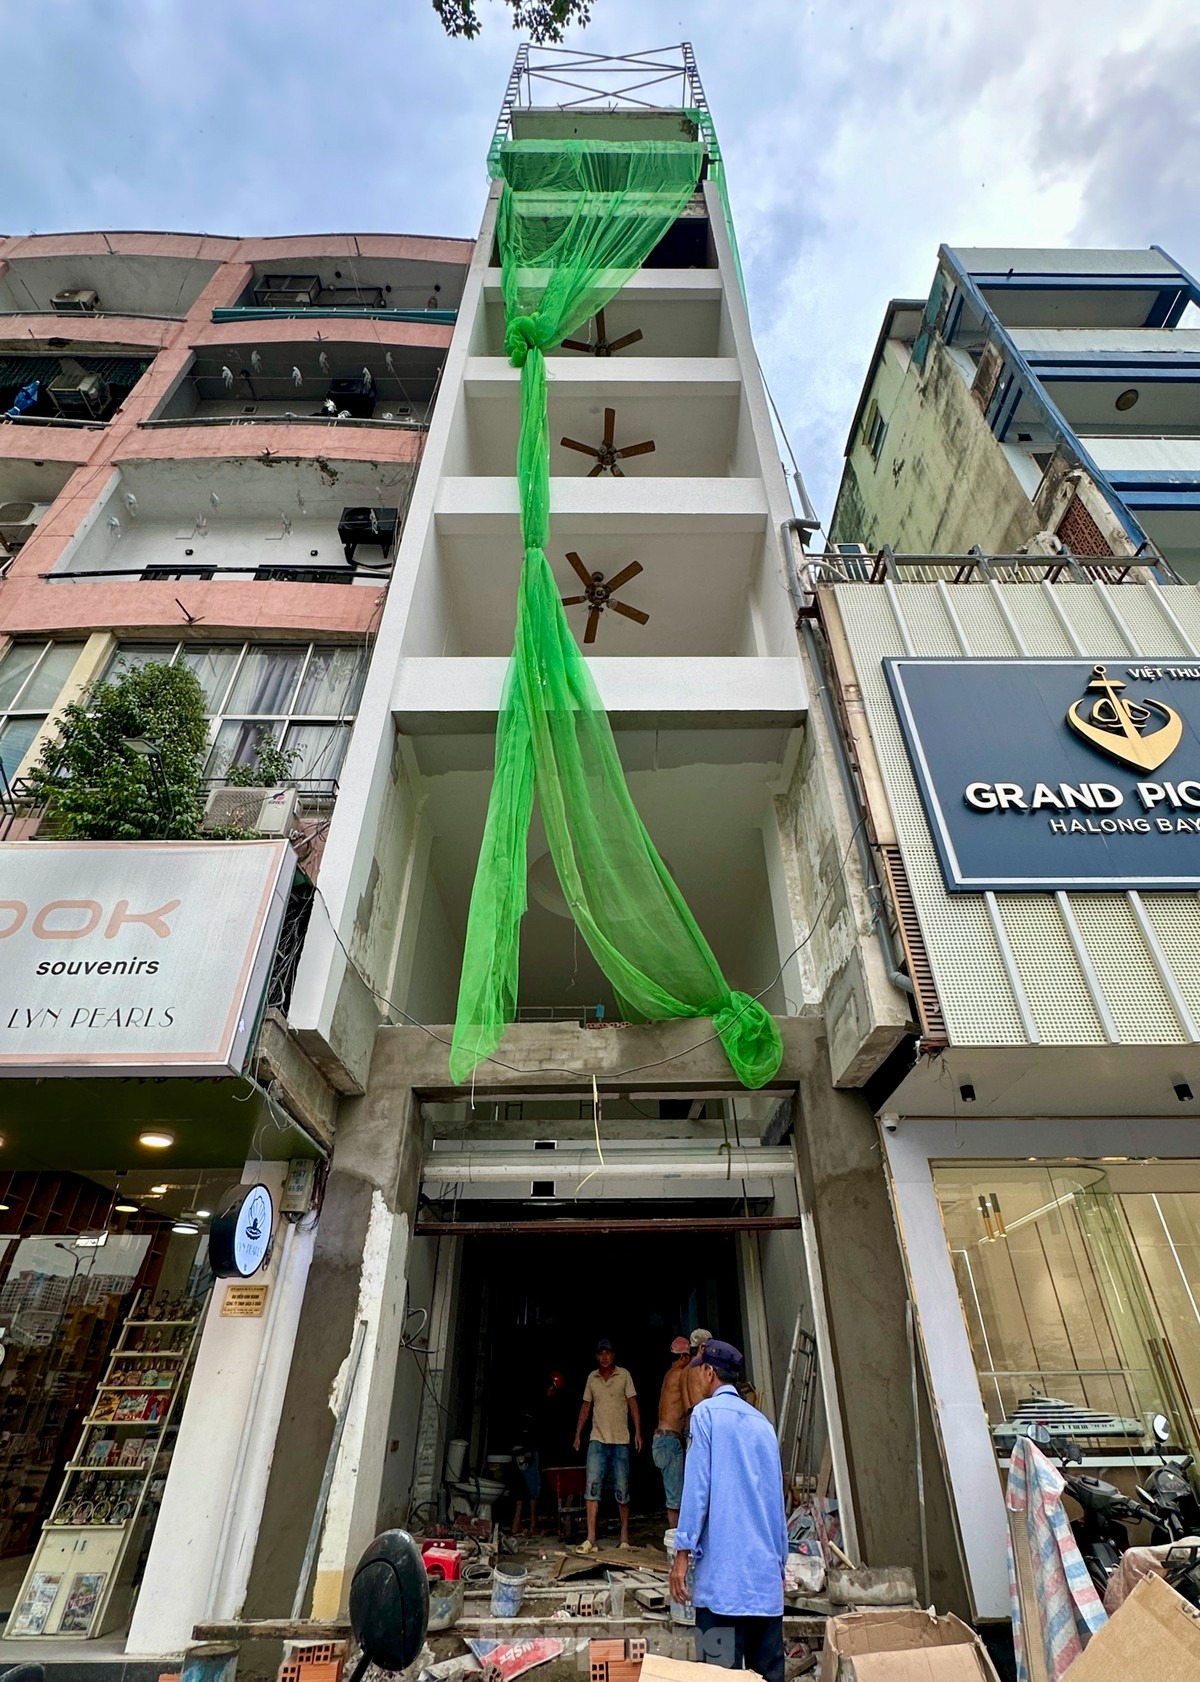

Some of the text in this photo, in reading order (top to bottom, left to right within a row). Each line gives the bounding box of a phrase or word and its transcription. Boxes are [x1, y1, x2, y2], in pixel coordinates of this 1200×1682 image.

[1127, 665, 1200, 681] VIỆT THU
[965, 782, 1124, 809] GRAND
[1050, 818, 1200, 832] HALONG BAY
[36, 957, 160, 976] souvenirs
[7, 1006, 175, 1028] LYN PEARLS
[499, 1641, 535, 1665] INSEE
